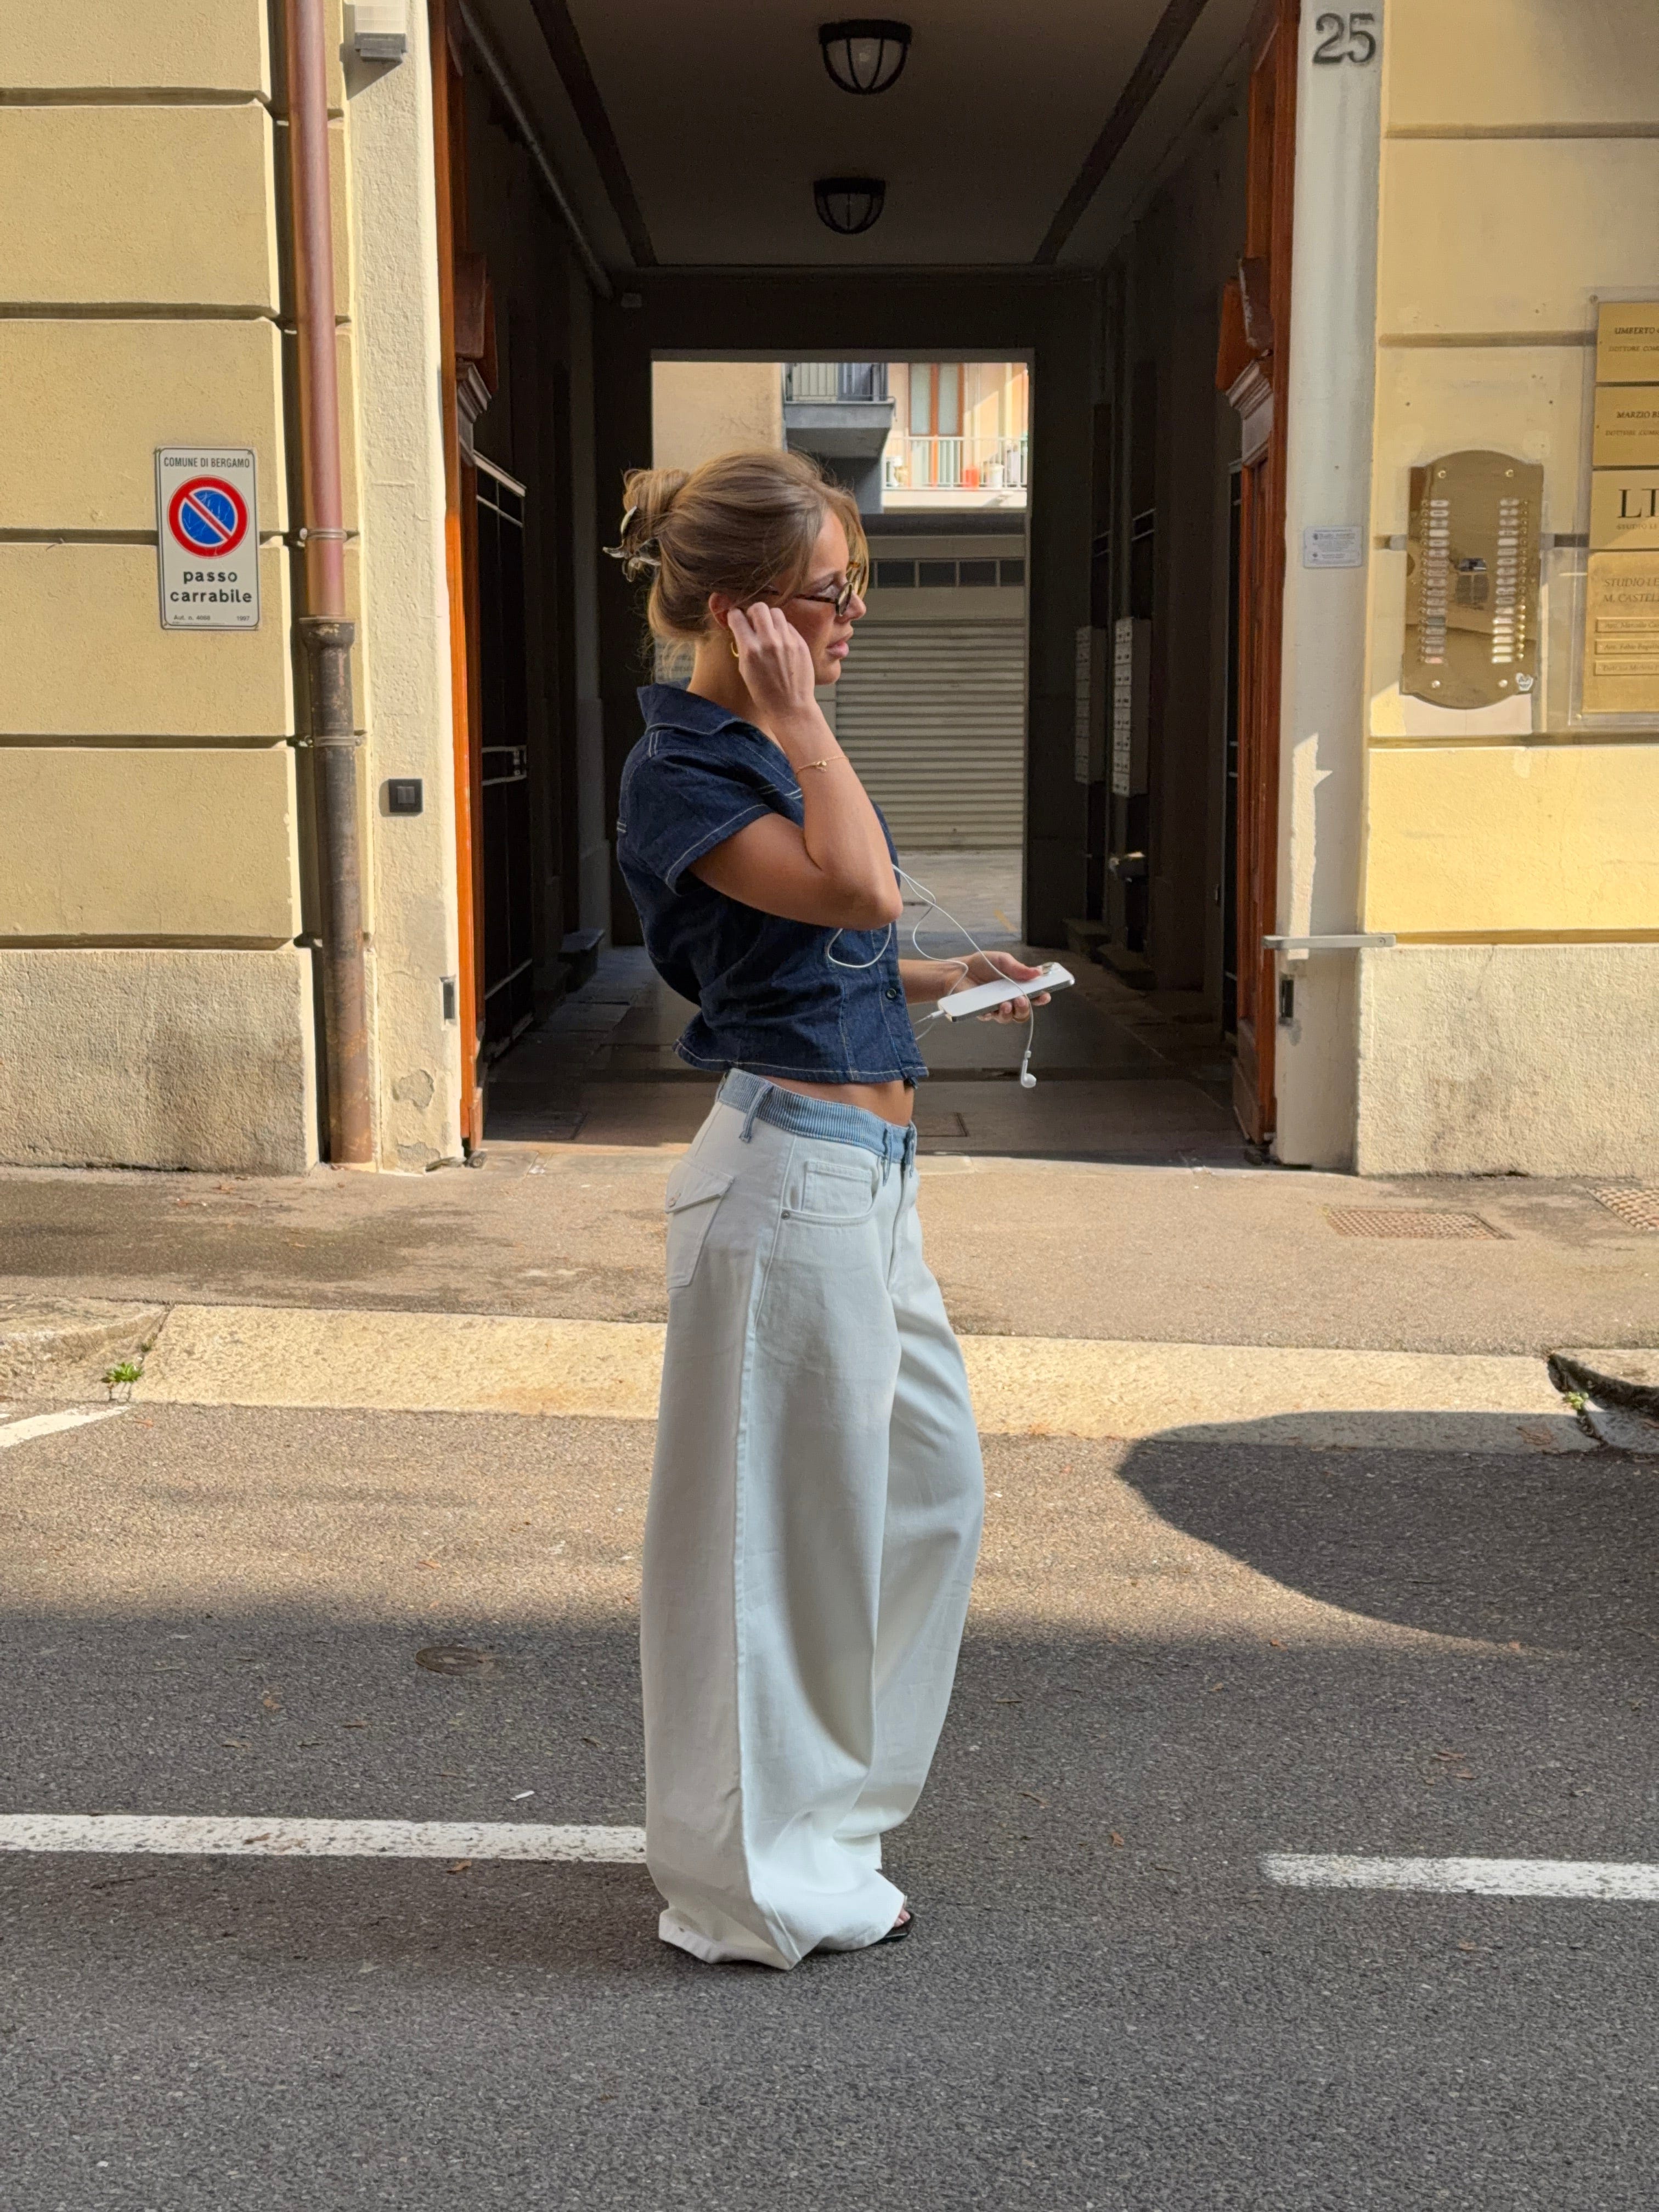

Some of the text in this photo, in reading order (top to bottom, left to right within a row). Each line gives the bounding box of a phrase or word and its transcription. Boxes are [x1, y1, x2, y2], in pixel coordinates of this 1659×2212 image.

[1313, 13, 1376, 64] 25
[163, 457, 250, 468] COMUNE DI BERGAMO
[183, 571, 238, 584] passo
[1603, 578, 1645, 586] STUDIO
[170, 589, 252, 603] carrabile
